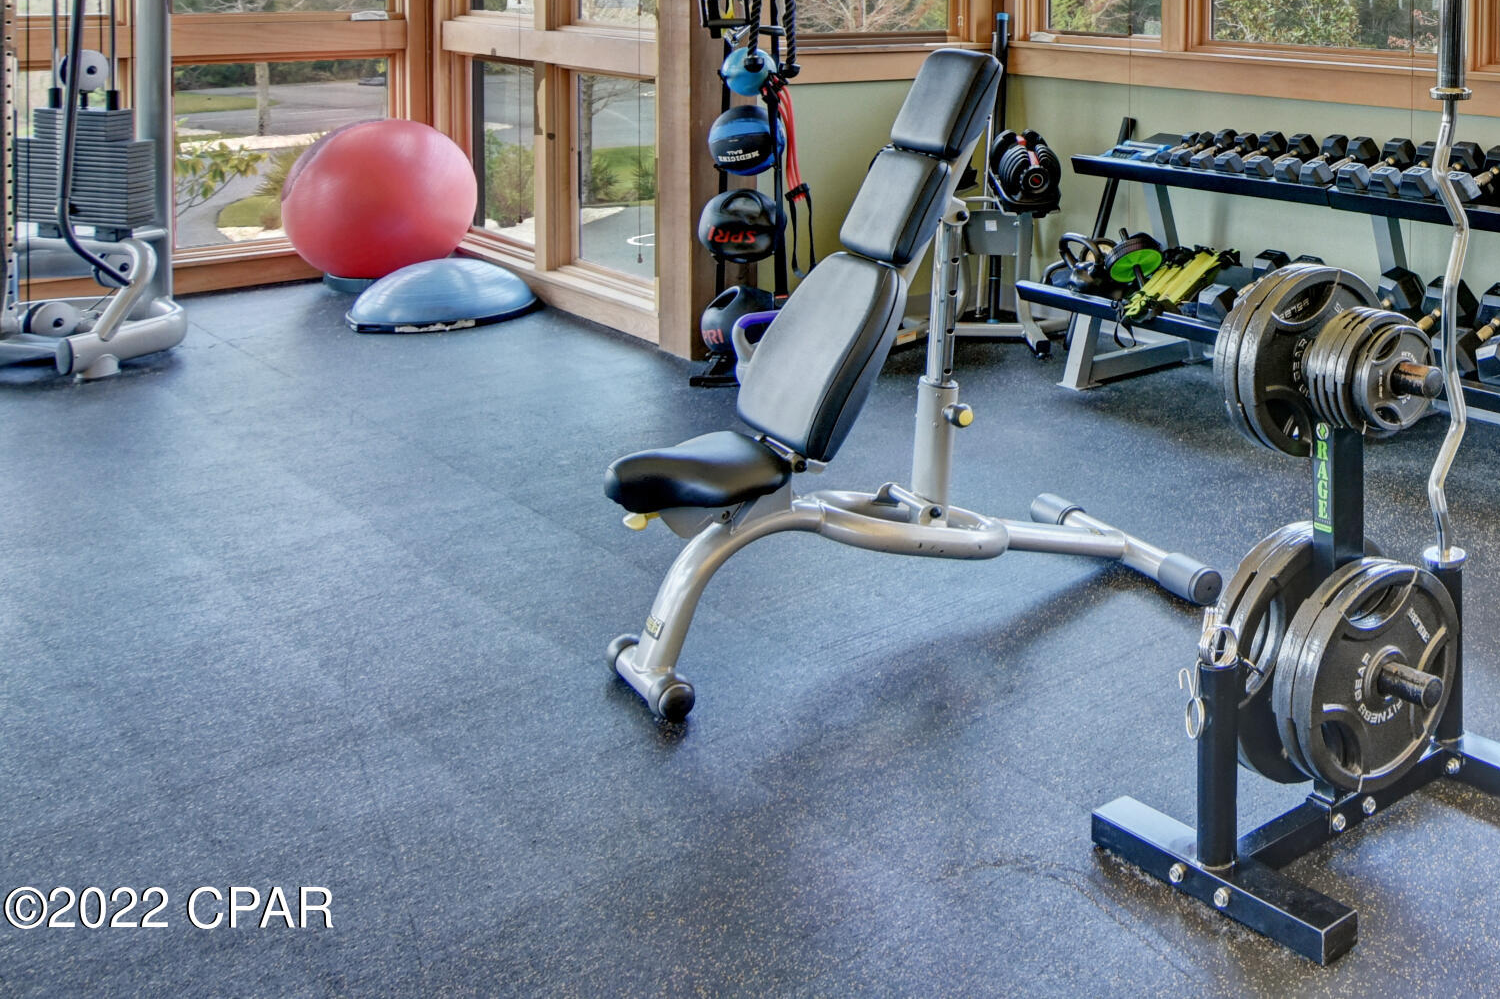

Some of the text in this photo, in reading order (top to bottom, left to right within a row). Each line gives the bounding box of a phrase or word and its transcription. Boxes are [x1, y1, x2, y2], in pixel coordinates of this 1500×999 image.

[718, 150, 760, 163] MEDICINE
[708, 226, 758, 244] SPRI
[703, 328, 725, 345] PRI
[1317, 440, 1328, 520] RAGE
[1354, 652, 1404, 725] FITNESS GEAR
